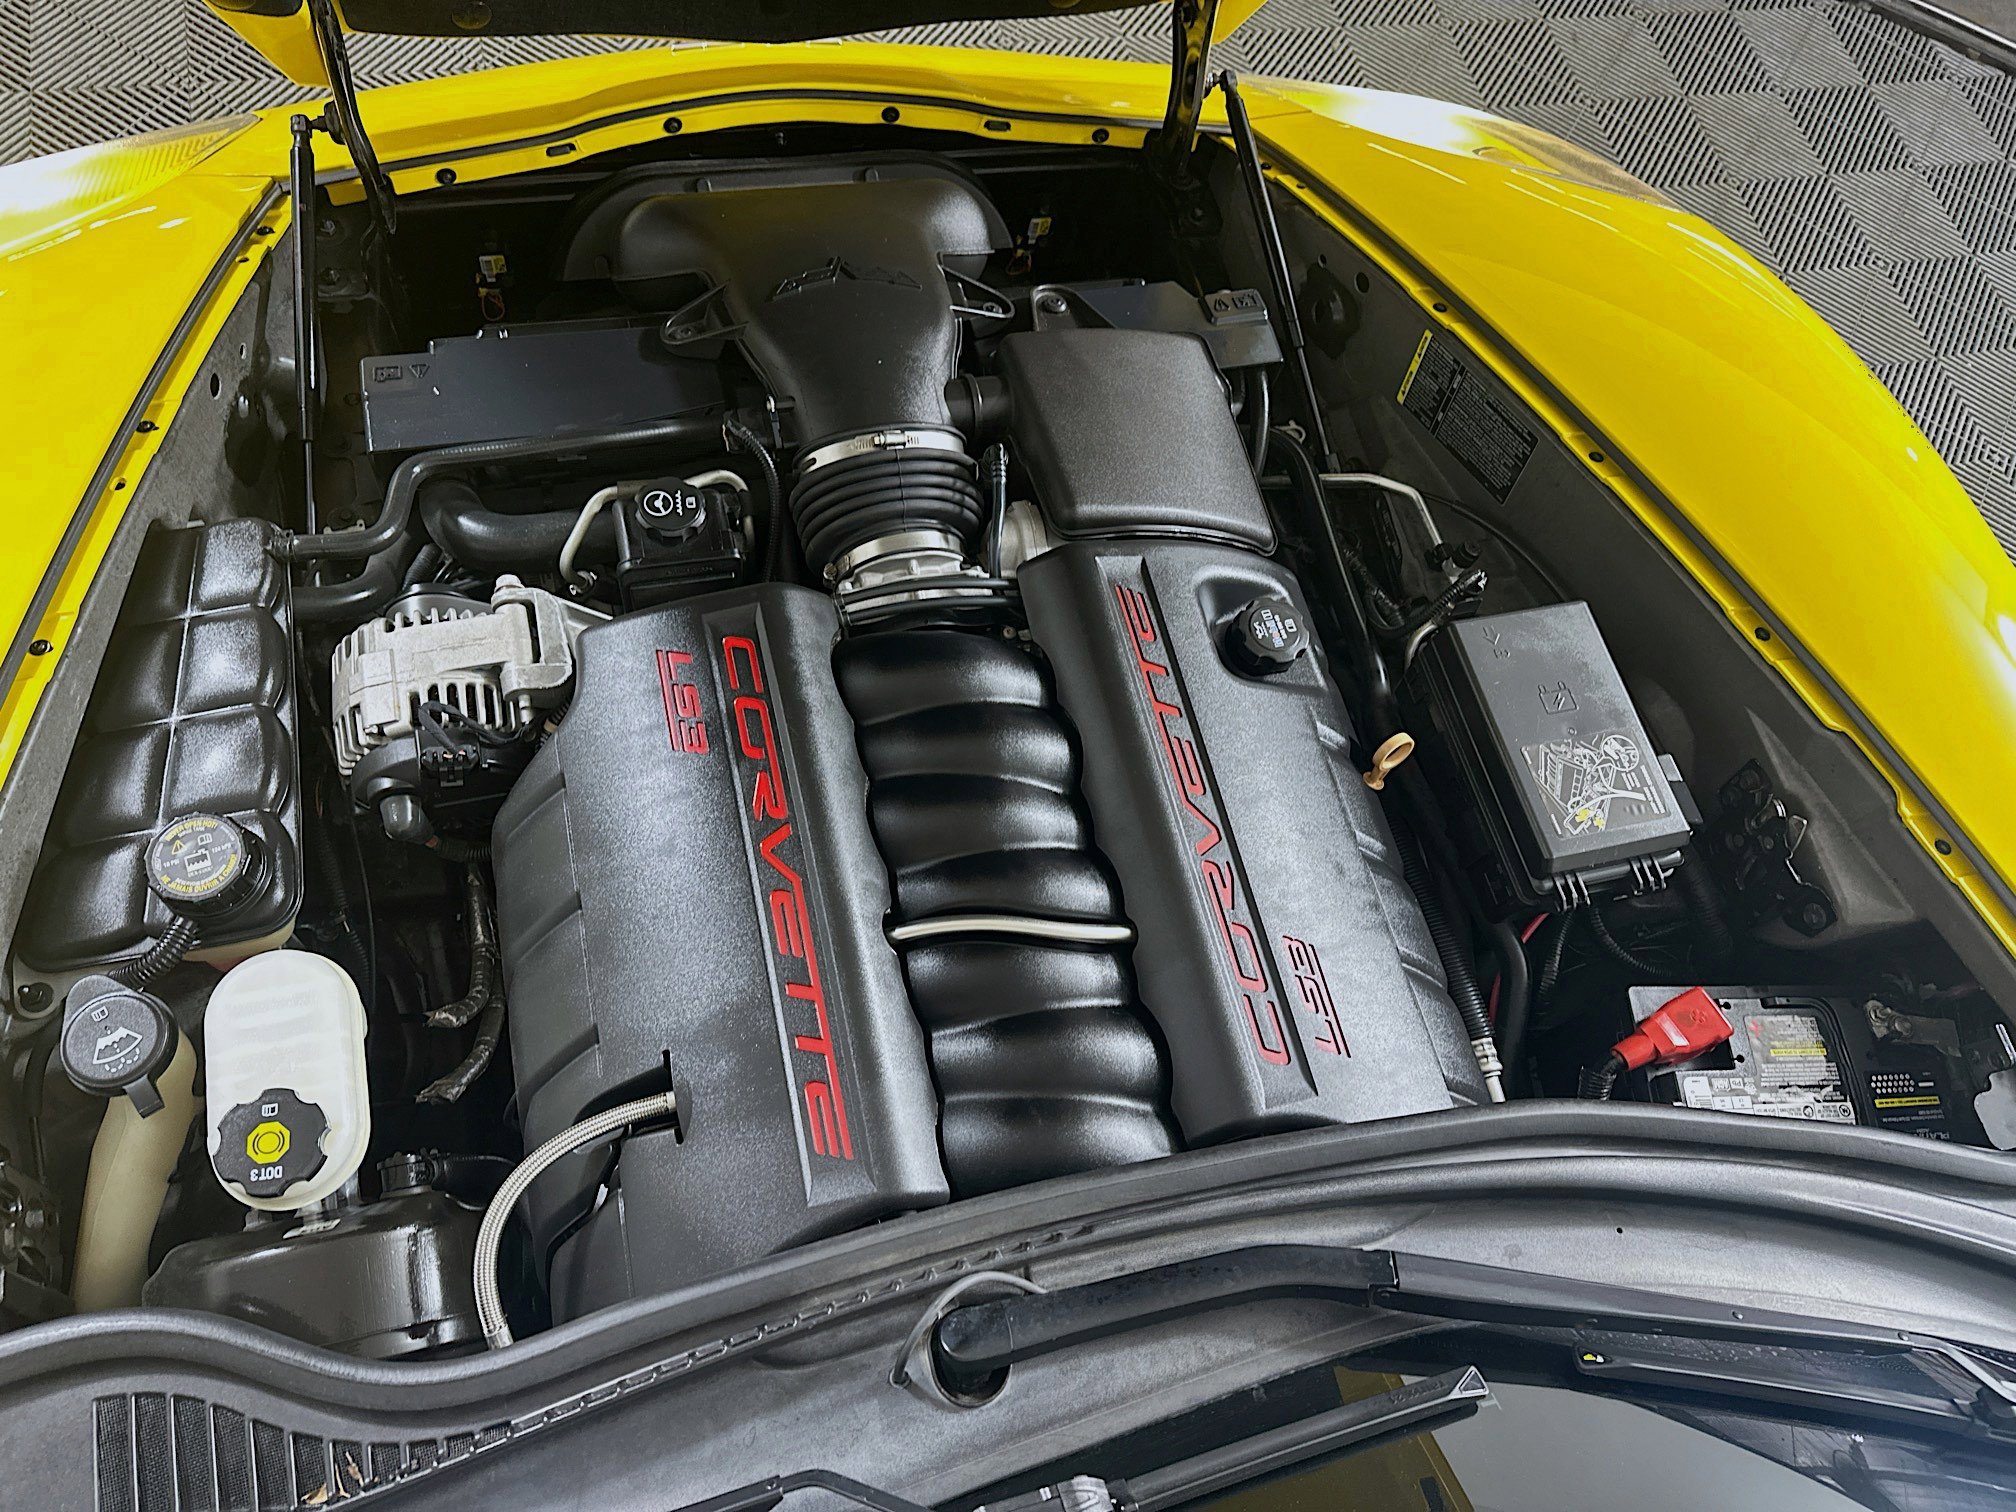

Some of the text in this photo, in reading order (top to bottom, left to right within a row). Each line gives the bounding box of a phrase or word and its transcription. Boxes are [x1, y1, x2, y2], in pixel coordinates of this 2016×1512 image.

[657, 649, 709, 755] LS3
[1115, 584, 1291, 1066] CORVETTE
[168, 881, 193, 893] JAMAIS
[721, 635, 854, 1161] CORVETTE
[1282, 935, 1350, 1058] LS3
